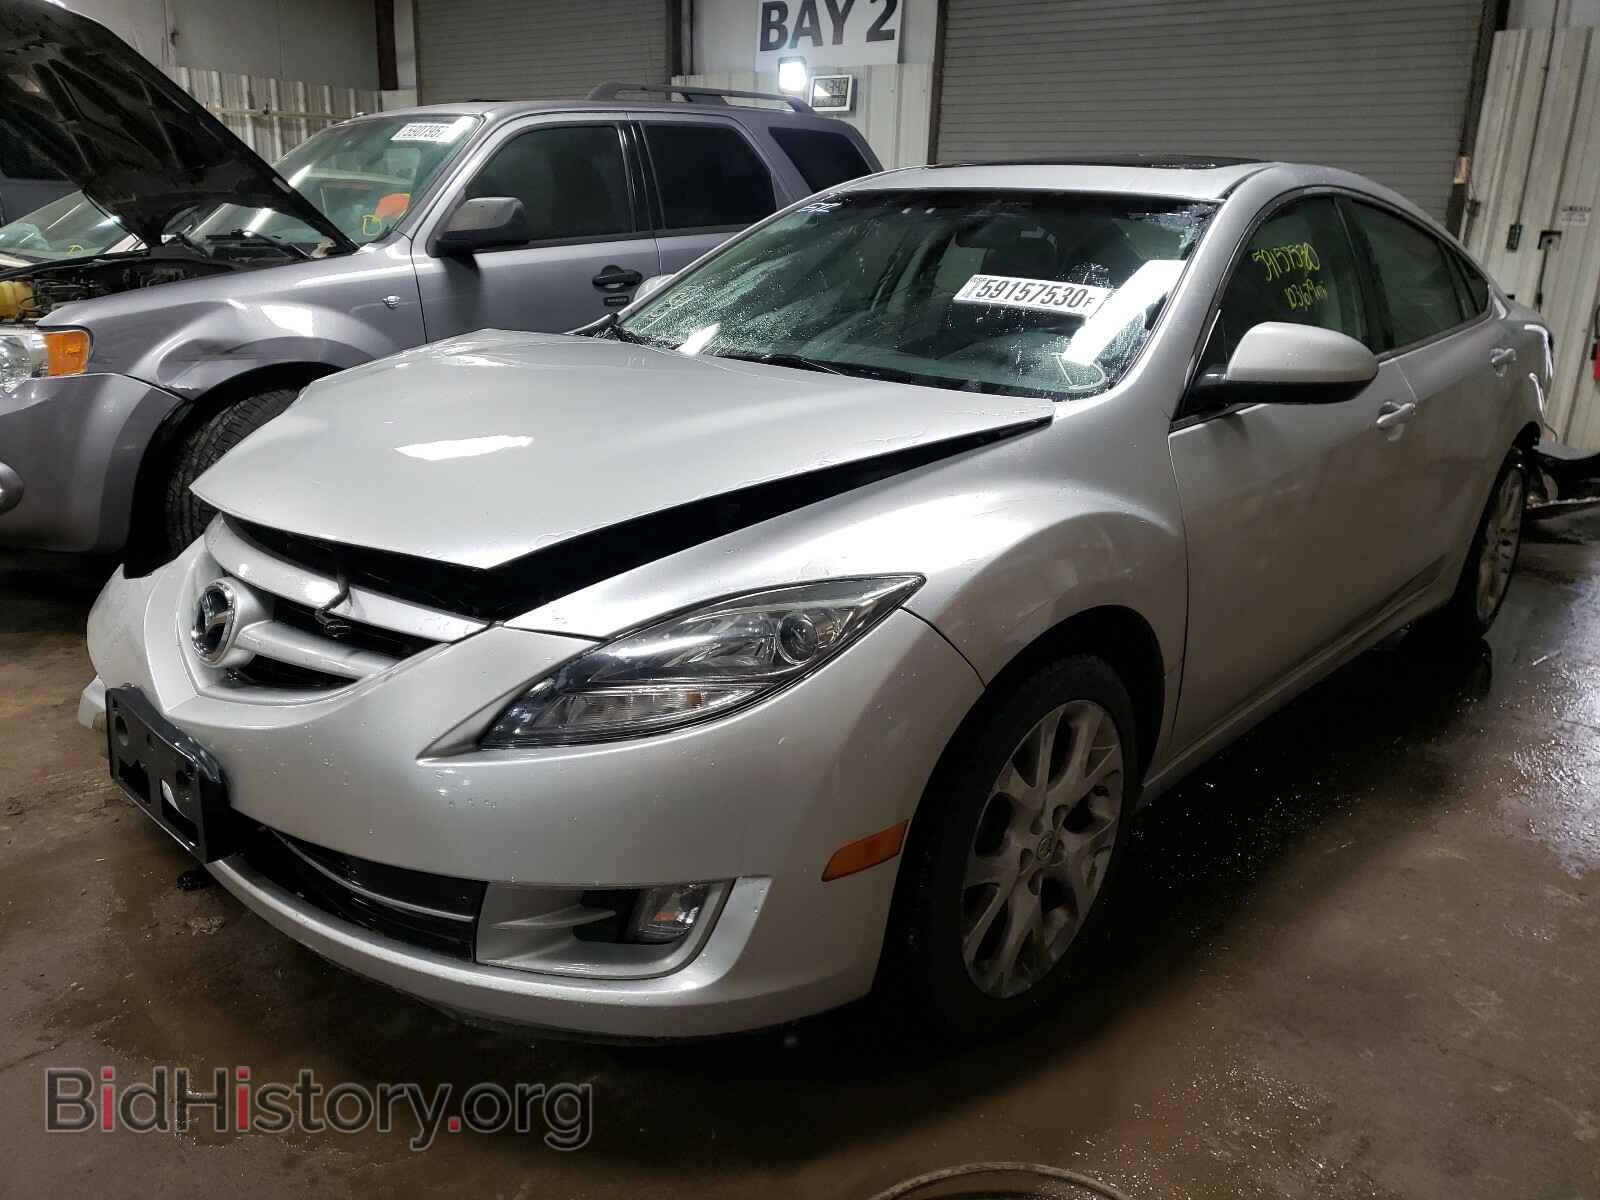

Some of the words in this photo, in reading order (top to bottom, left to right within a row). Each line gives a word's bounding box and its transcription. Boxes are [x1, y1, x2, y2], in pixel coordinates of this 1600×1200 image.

[760, 0, 855, 51] BAY
[866, 0, 898, 42] 2
[976, 279, 1088, 308] 59157530
[1083, 296, 1095, 308] F
